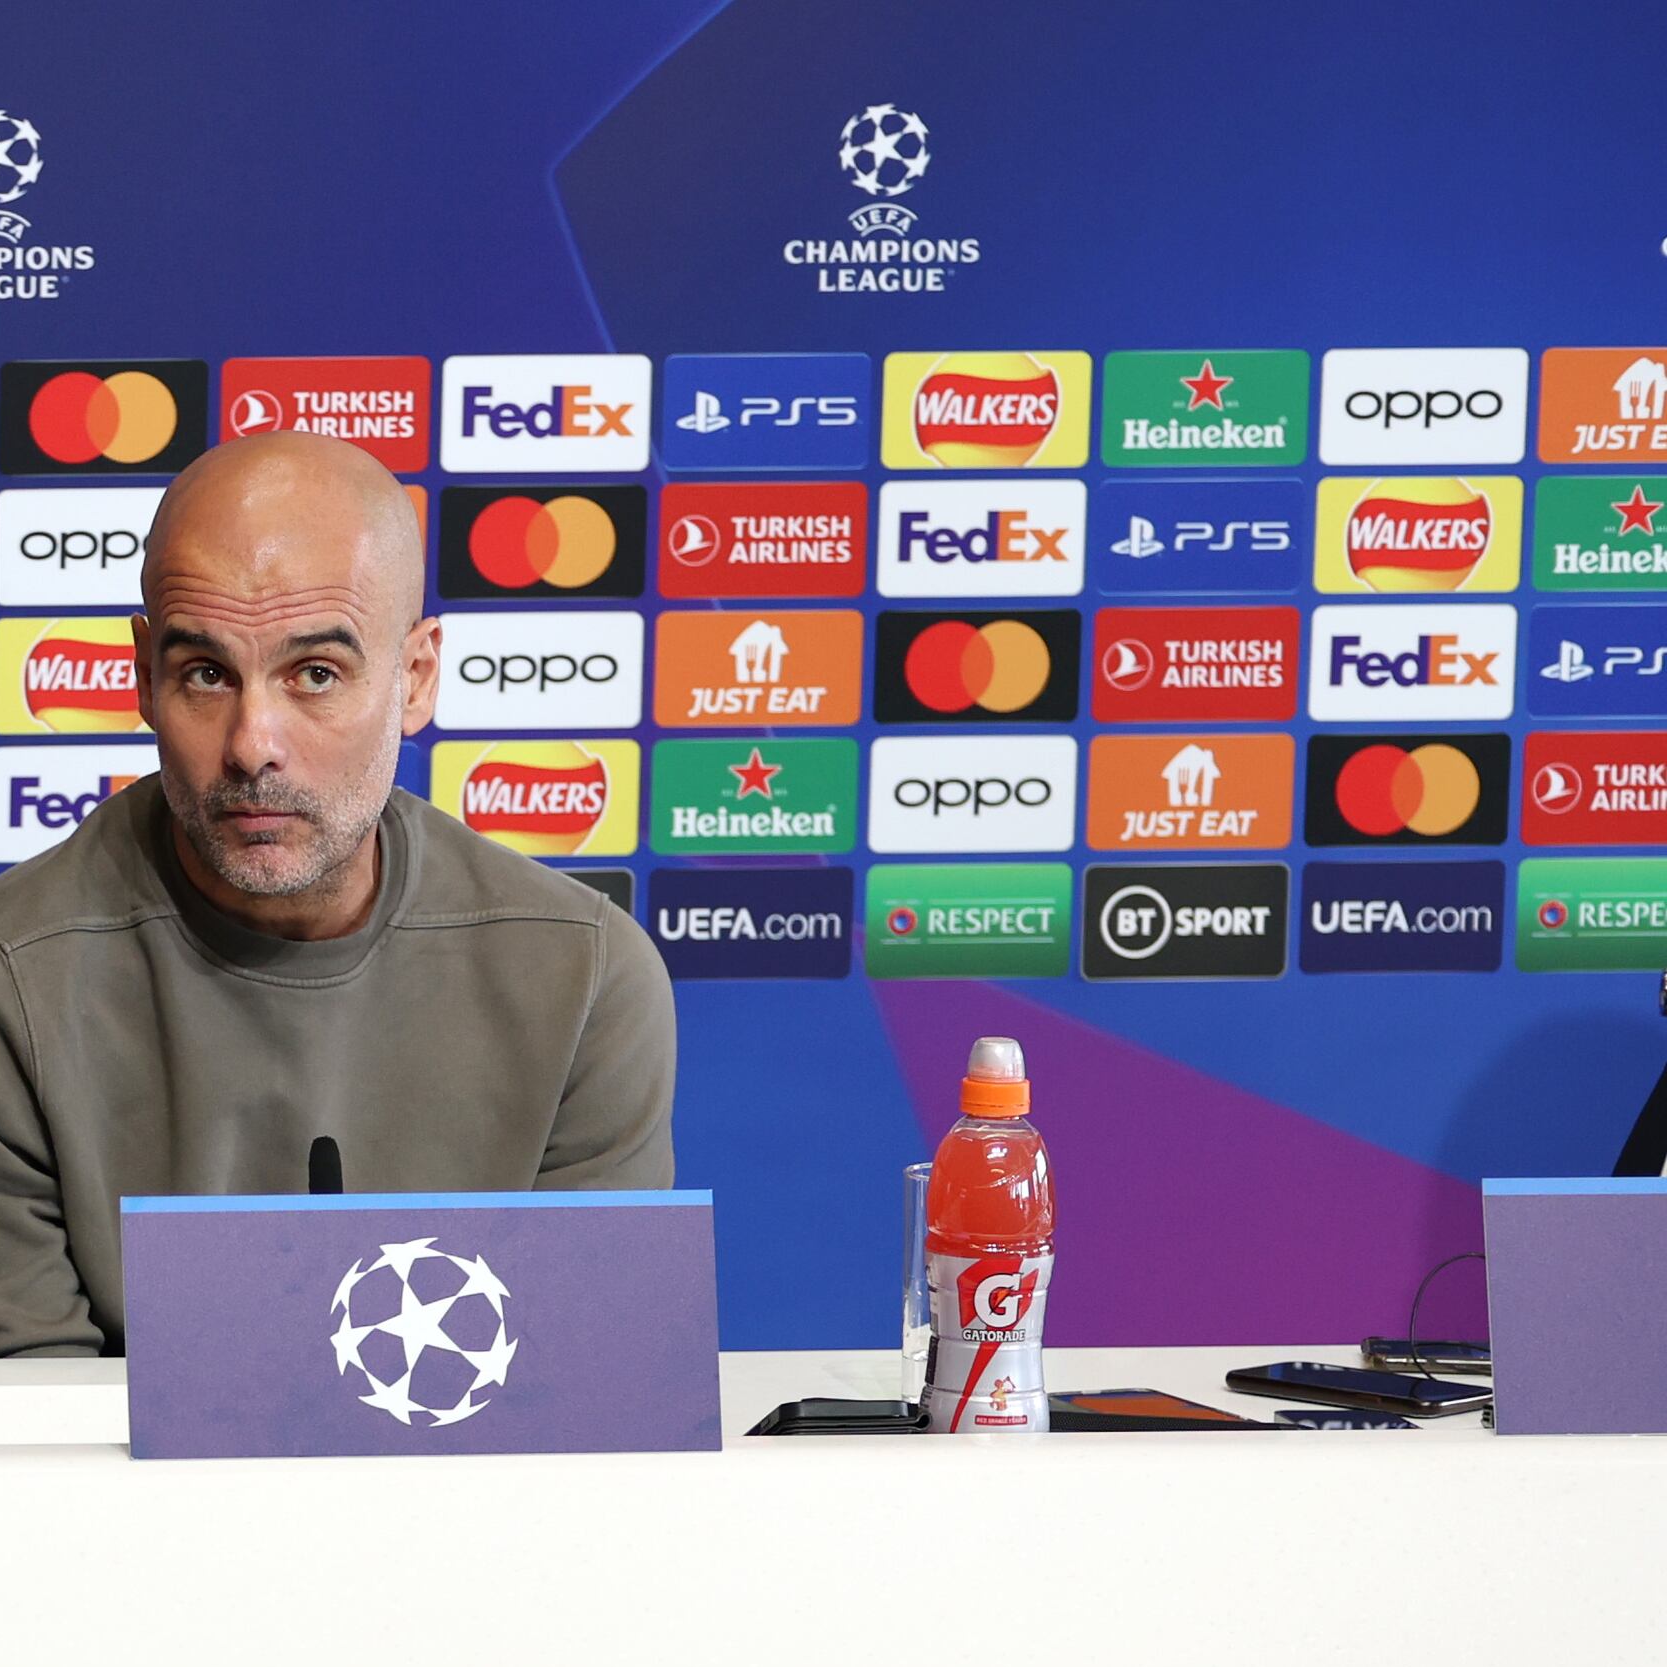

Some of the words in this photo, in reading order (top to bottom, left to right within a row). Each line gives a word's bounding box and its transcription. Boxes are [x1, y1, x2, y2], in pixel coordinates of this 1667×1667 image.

[852, 208, 912, 232] UEFA
[785, 239, 979, 263] CHAMPIONS
[820, 269, 943, 291] LEAGUE
[294, 391, 413, 413] TURKISH
[464, 386, 632, 437] FedEx
[741, 398, 856, 425] PS5
[917, 389, 1055, 426] WALKERS
[1346, 391, 1502, 428] oppo
[293, 415, 415, 439] AIRLINES
[1123, 419, 1284, 448] Heineken
[1572, 425, 1646, 453] JUST
[732, 516, 850, 538] TURKISH
[901, 511, 1066, 561] FedEx
[1175, 522, 1289, 550] PS5
[1351, 513, 1487, 549] WALKERS
[21, 531, 147, 569] opp
[729, 541, 851, 563] AIRLINES
[1553, 543, 1667, 574] Heinek
[1166, 641, 1282, 662] TURKISH
[1333, 634, 1497, 685] FedEx
[1604, 647, 1667, 675] PS
[28, 653, 137, 691] WALKE
[460, 655, 617, 691] oppo
[1163, 665, 1282, 687] AIRLINES
[688, 688, 763, 717] JUST
[768, 688, 826, 713] EAT
[1593, 764, 1667, 786] TURK
[10, 775, 139, 827] Fed
[465, 775, 605, 812] WALKERS
[895, 779, 1050, 815] oppo
[1590, 789, 1667, 811] AIRLI
[672, 807, 834, 837] Heineken
[1121, 811, 1195, 840] JUST
[1199, 811, 1258, 836] EAT
[659, 907, 841, 941] UEFA.com
[929, 911, 1053, 933] RESPECT
[1116, 908, 1155, 936] BT
[1176, 907, 1270, 936] SPORT
[1313, 901, 1491, 933] UEFA.com
[1579, 901, 1667, 928] RESPE
[975, 1273, 1023, 1327] G
[963, 1330, 1025, 1341] GATORADE
